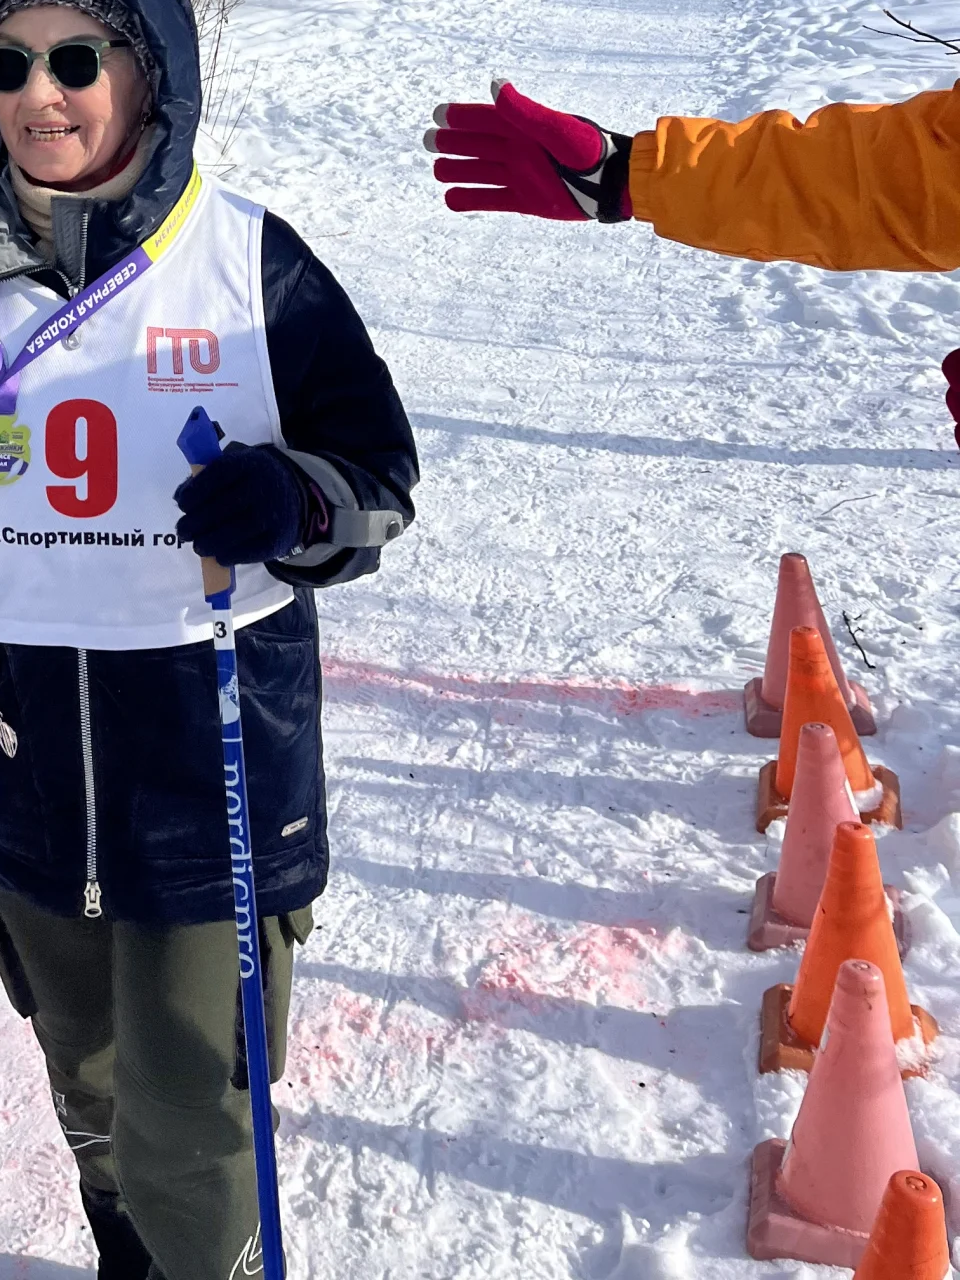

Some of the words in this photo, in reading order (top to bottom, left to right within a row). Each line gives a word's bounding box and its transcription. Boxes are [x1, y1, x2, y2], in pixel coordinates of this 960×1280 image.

[76, 262, 137, 317] СЕВЕРНАЯ
[26, 309, 77, 354] ХОДЬБА
[147, 327, 220, 374] ГТО
[44, 398, 118, 518] 9
[223, 759, 255, 980] nordicpro
